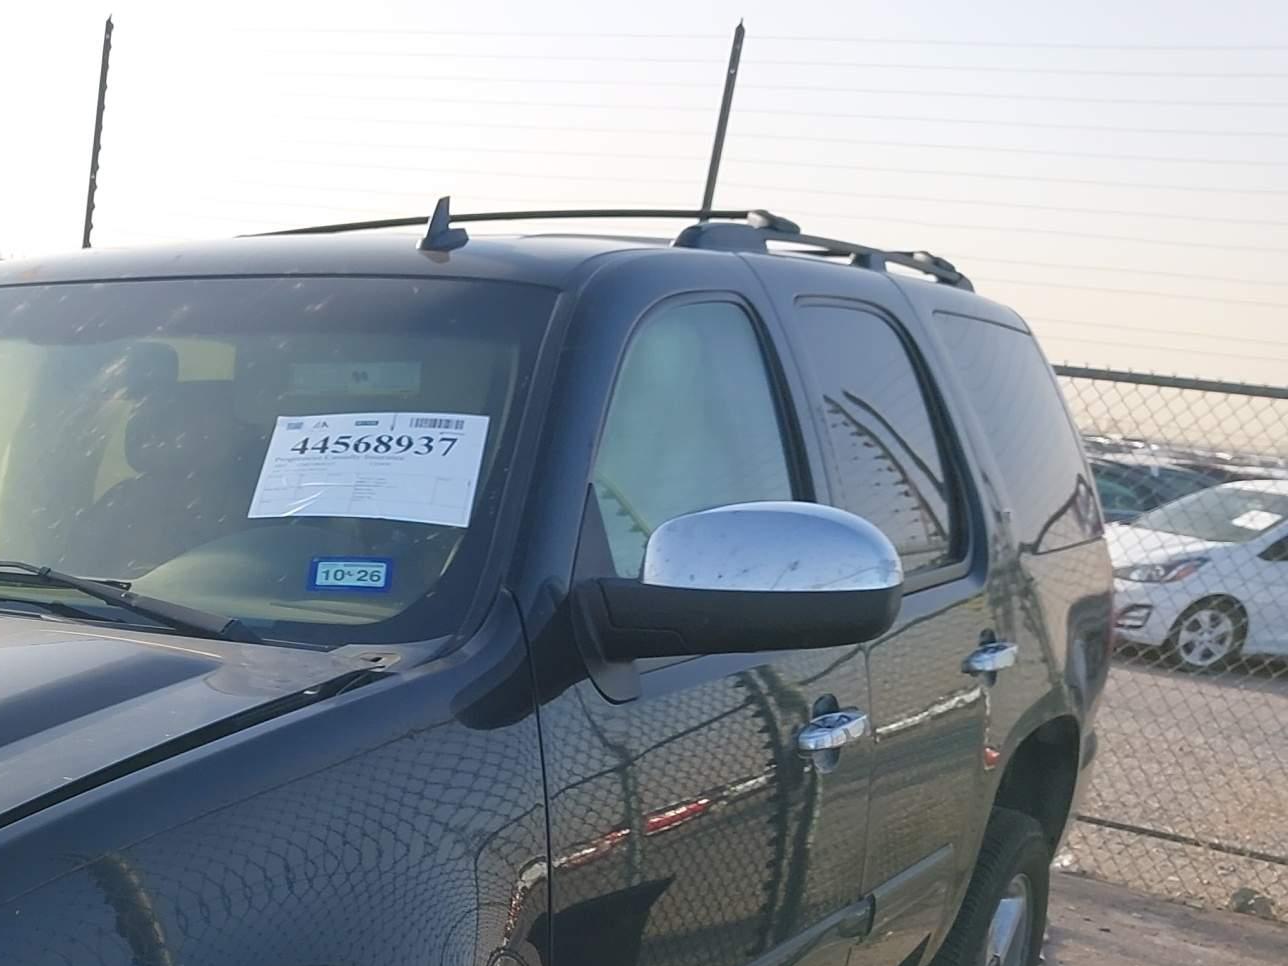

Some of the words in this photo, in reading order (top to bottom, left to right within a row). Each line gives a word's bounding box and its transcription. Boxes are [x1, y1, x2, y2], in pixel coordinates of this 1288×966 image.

[290, 434, 459, 457] 44568937
[321, 568, 346, 582] 10
[356, 568, 382, 583] 26
